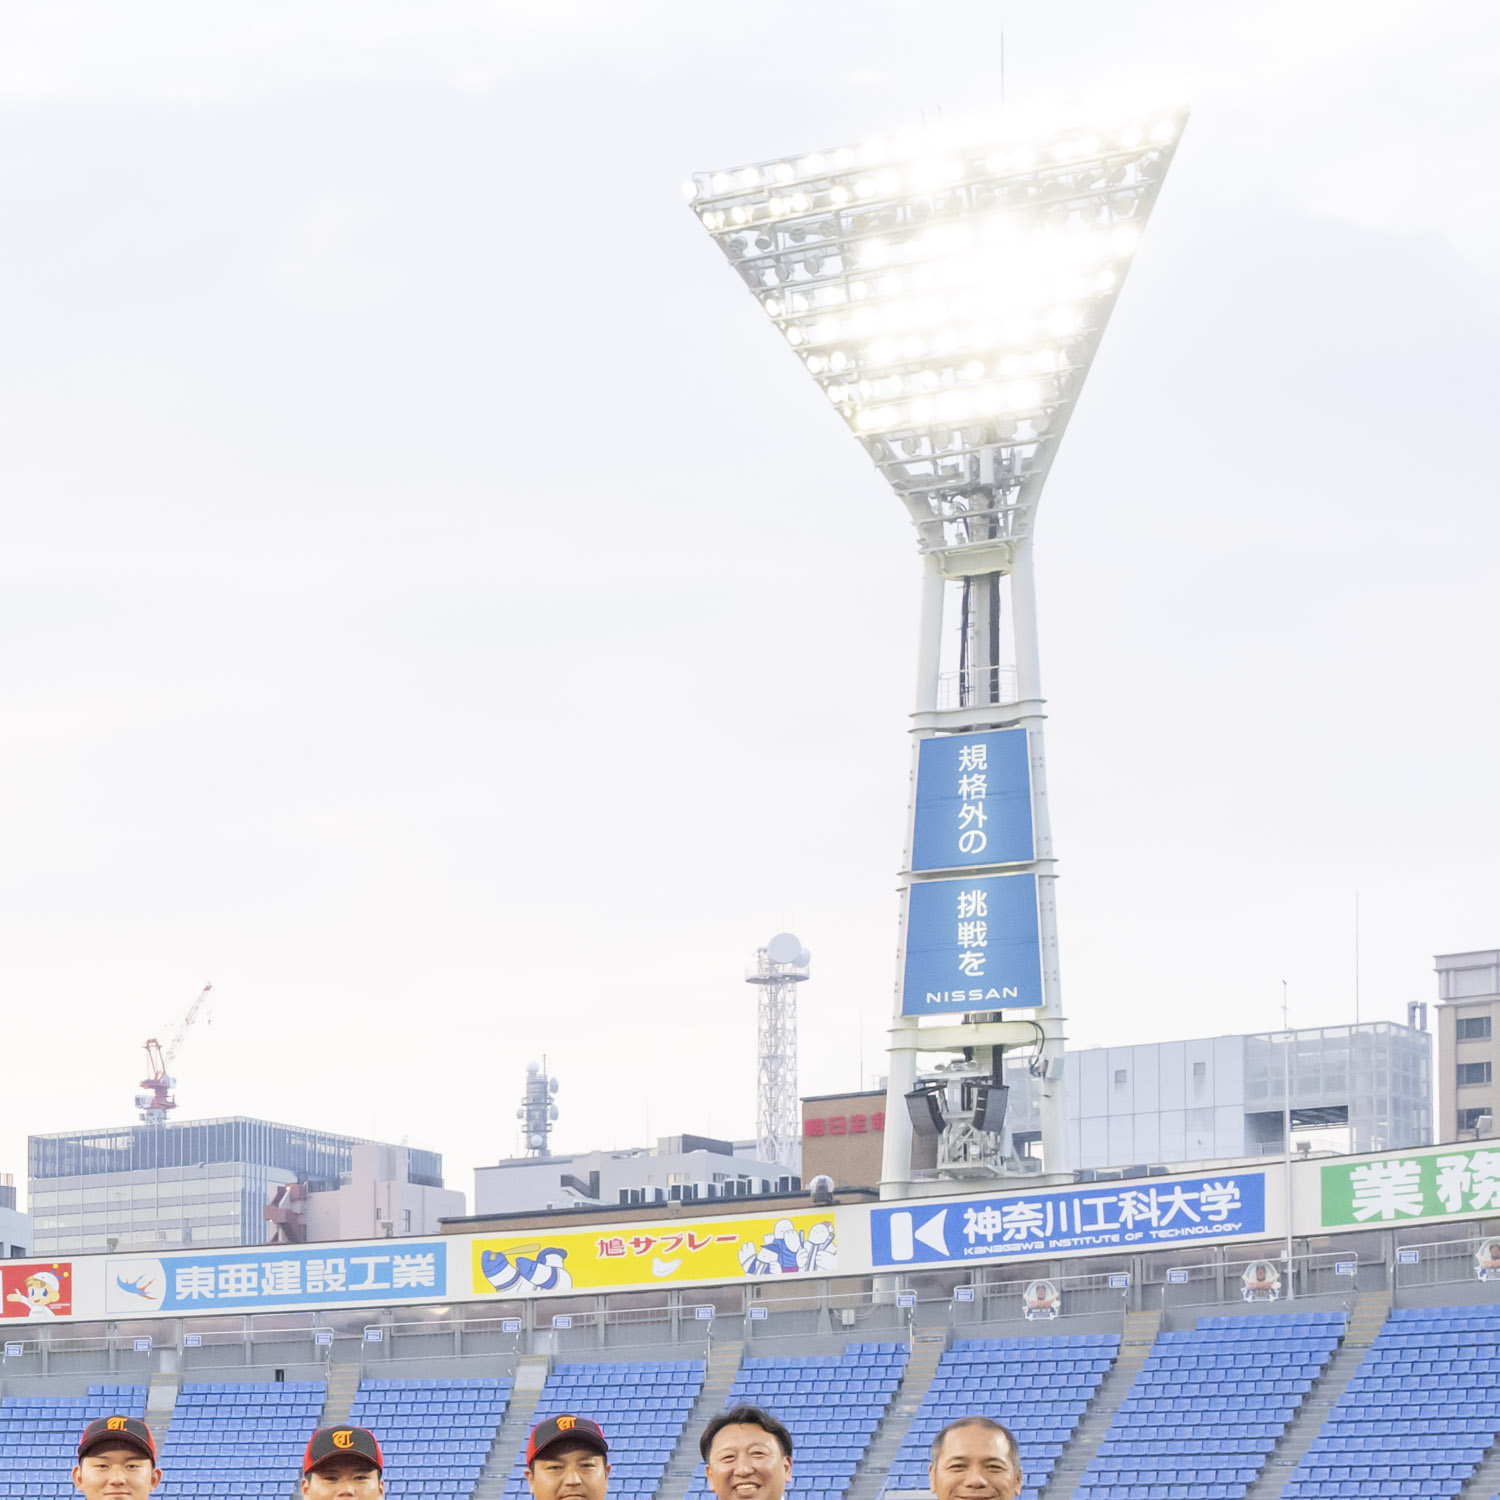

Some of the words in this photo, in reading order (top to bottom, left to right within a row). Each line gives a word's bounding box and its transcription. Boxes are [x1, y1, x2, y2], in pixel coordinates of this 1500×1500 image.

[958, 744, 988, 854] 規格外の
[957, 890, 988, 977] 挑戦を
[926, 986, 1018, 1003] NISSAN
[962, 1180, 1242, 1245] 神奈川工科大学
[1049, 1233, 1120, 1249] INSTITUTE
[1124, 1230, 1144, 1242] OF
[1149, 1222, 1243, 1241] TECHNOLOGY
[597, 1231, 739, 1259] 鳩サブレー
[175, 1253, 436, 1301] 東亜建設工業
